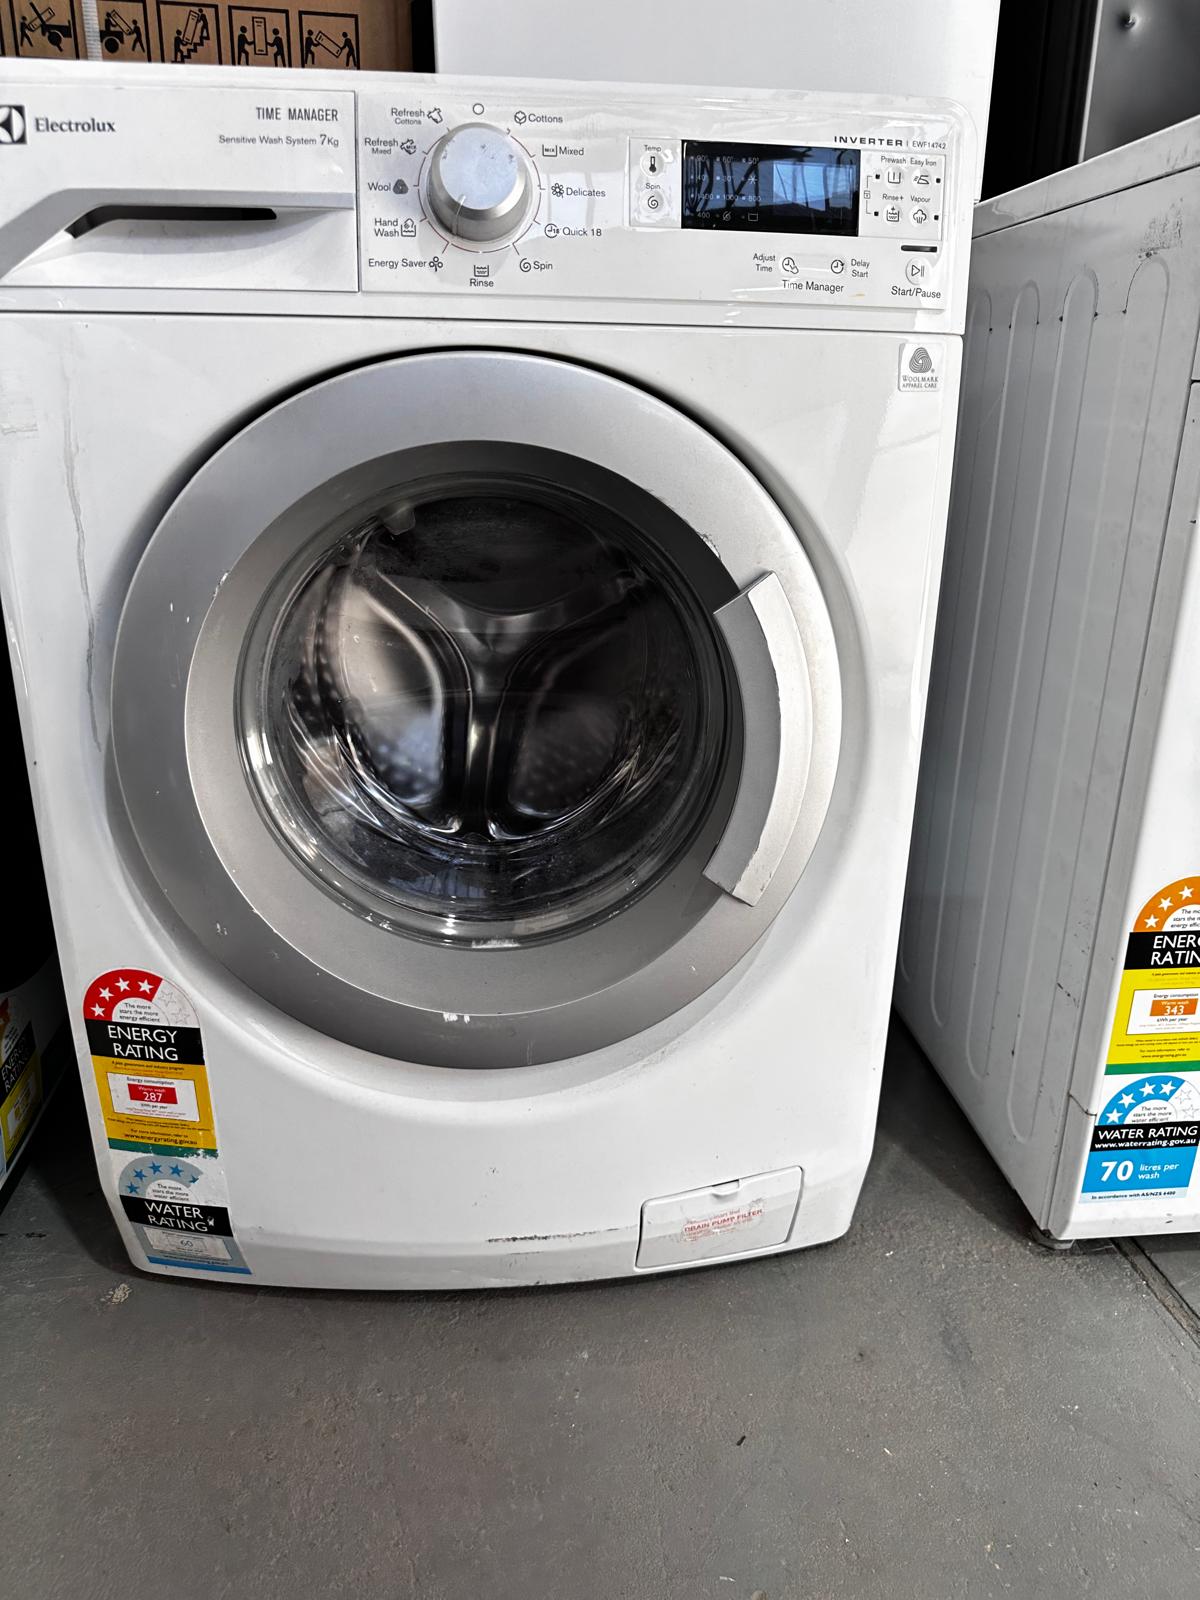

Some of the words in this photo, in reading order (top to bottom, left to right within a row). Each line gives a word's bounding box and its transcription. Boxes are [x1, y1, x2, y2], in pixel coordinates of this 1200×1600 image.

[256, 107, 281, 120] TIME
[288, 108, 338, 122] MANAGER
[391, 108, 425, 118] Refresh
[528, 114, 563, 124] Cottons
[35, 117, 116, 132] Electrolux
[218, 134, 256, 144] Sensitive
[259, 135, 283, 145] Wash
[286, 136, 317, 146] System
[320, 134, 339, 148] 7Kg
[364, 138, 398, 148] Refresh
[834, 136, 903, 147] INVERTER
[912, 140, 946, 150] EWF14742
[558, 146, 584, 156] Mixed
[644, 144, 662, 154] Temp
[880, 156, 906, 164] Prewash
[910, 158, 924, 167] Easy
[926, 158, 936, 166] Iron
[368, 182, 392, 192] Wool
[646, 182, 660, 192] Spin
[566, 188, 606, 198] Delicates
[910, 195, 931, 203] Vapour
[374, 218, 398, 228] Hand
[374, 228, 400, 238] Wash
[562, 228, 588, 238] Quick
[590, 228, 602, 237] 18
[368, 258, 398, 268] Energy
[402, 259, 428, 268] Saver
[752, 252, 776, 264] Adjust
[533, 261, 553, 272] Spin
[756, 263, 772, 273] Time
[850, 258, 870, 270] Delay
[851, 269, 869, 279] Start
[469, 278, 494, 288] Rinse
[782, 279, 804, 291] Time
[806, 280, 844, 294] Manager
[890, 286, 942, 300] Start/Pause
[1152, 934, 1200, 949] ENER
[1164, 1005, 1184, 1016] 343
[107, 1025, 178, 1044] ENERGY
[112, 1042, 178, 1061] RATING
[143, 1092, 162, 1102] 287
[1098, 1128, 1144, 1140] WATER
[1148, 1126, 1198, 1138] RATING
[1094, 1138, 1196, 1149] www.waterrating.gov.au
[1101, 1160, 1134, 1182] 70
[1163, 1164, 1180, 1172] per
[1138, 1172, 1160, 1180] wash
[144, 1201, 204, 1219] WATER
[148, 1214, 208, 1232] RATING
[684, 1222, 710, 1232] DRAIN
[712, 1216, 736, 1227] PUMP
[736, 1208, 762, 1220] FILTER
